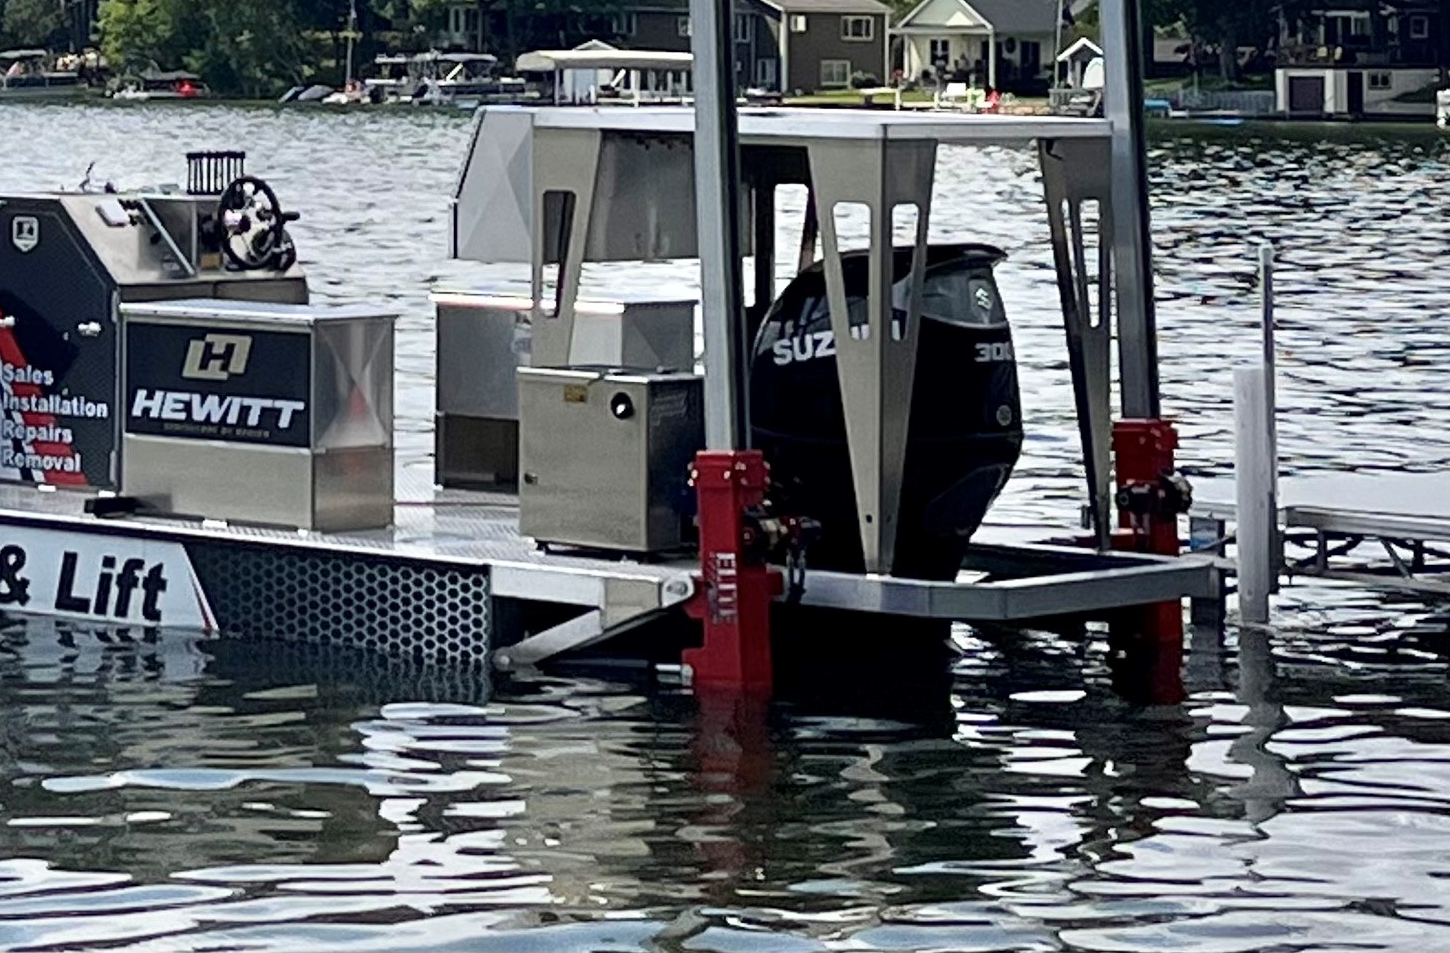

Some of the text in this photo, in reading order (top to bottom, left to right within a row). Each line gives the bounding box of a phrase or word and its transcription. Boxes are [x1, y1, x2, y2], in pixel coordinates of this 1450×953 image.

[1, 363, 54, 385] Sales
[3, 391, 109, 418] Installation
[131, 388, 306, 429] HEWITT
[1, 419, 73, 445] Repairs
[1, 445, 82, 472] Removal
[54, 550, 168, 622] Lift
